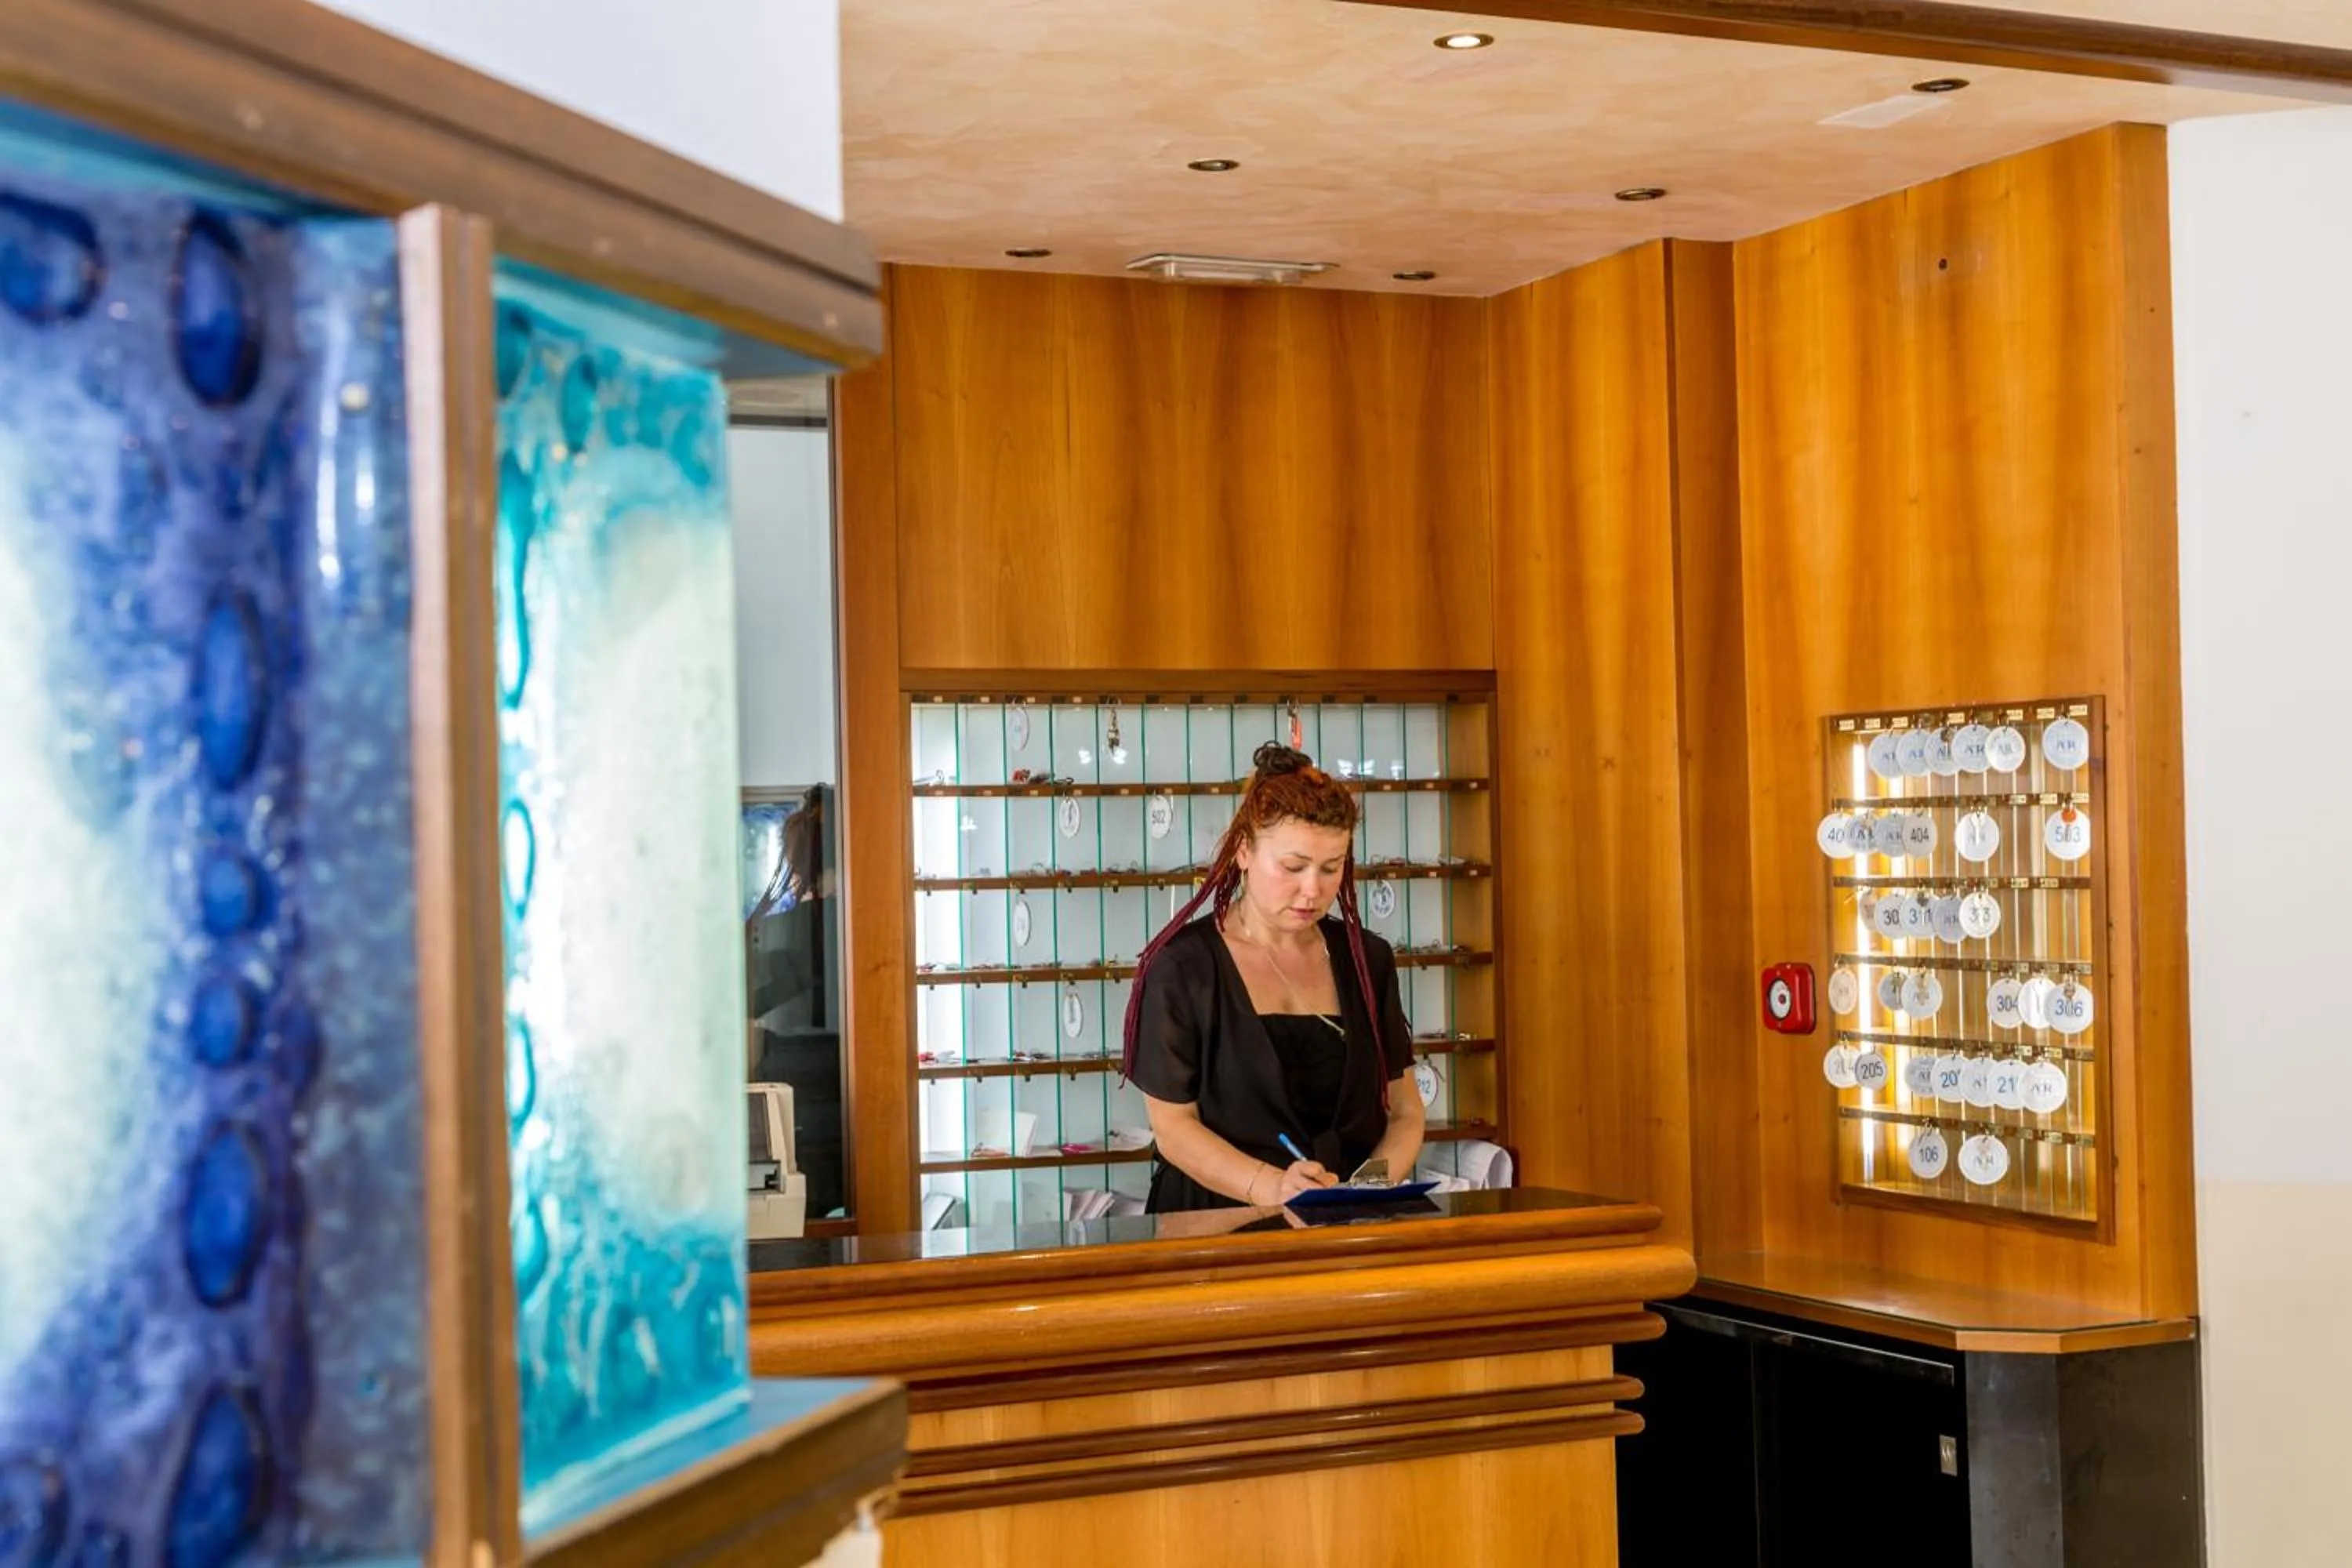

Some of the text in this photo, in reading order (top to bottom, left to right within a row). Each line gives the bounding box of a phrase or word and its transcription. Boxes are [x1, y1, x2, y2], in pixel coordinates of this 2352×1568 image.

[1828, 827, 1845, 843] 40
[1910, 827, 1929, 843] 404
[2055, 826, 2081, 843] 503
[1882, 909, 1900, 925] 30
[2055, 998, 2083, 1017] 306
[1940, 1069, 1961, 1089] 20
[1919, 1145, 1939, 1163] 106
